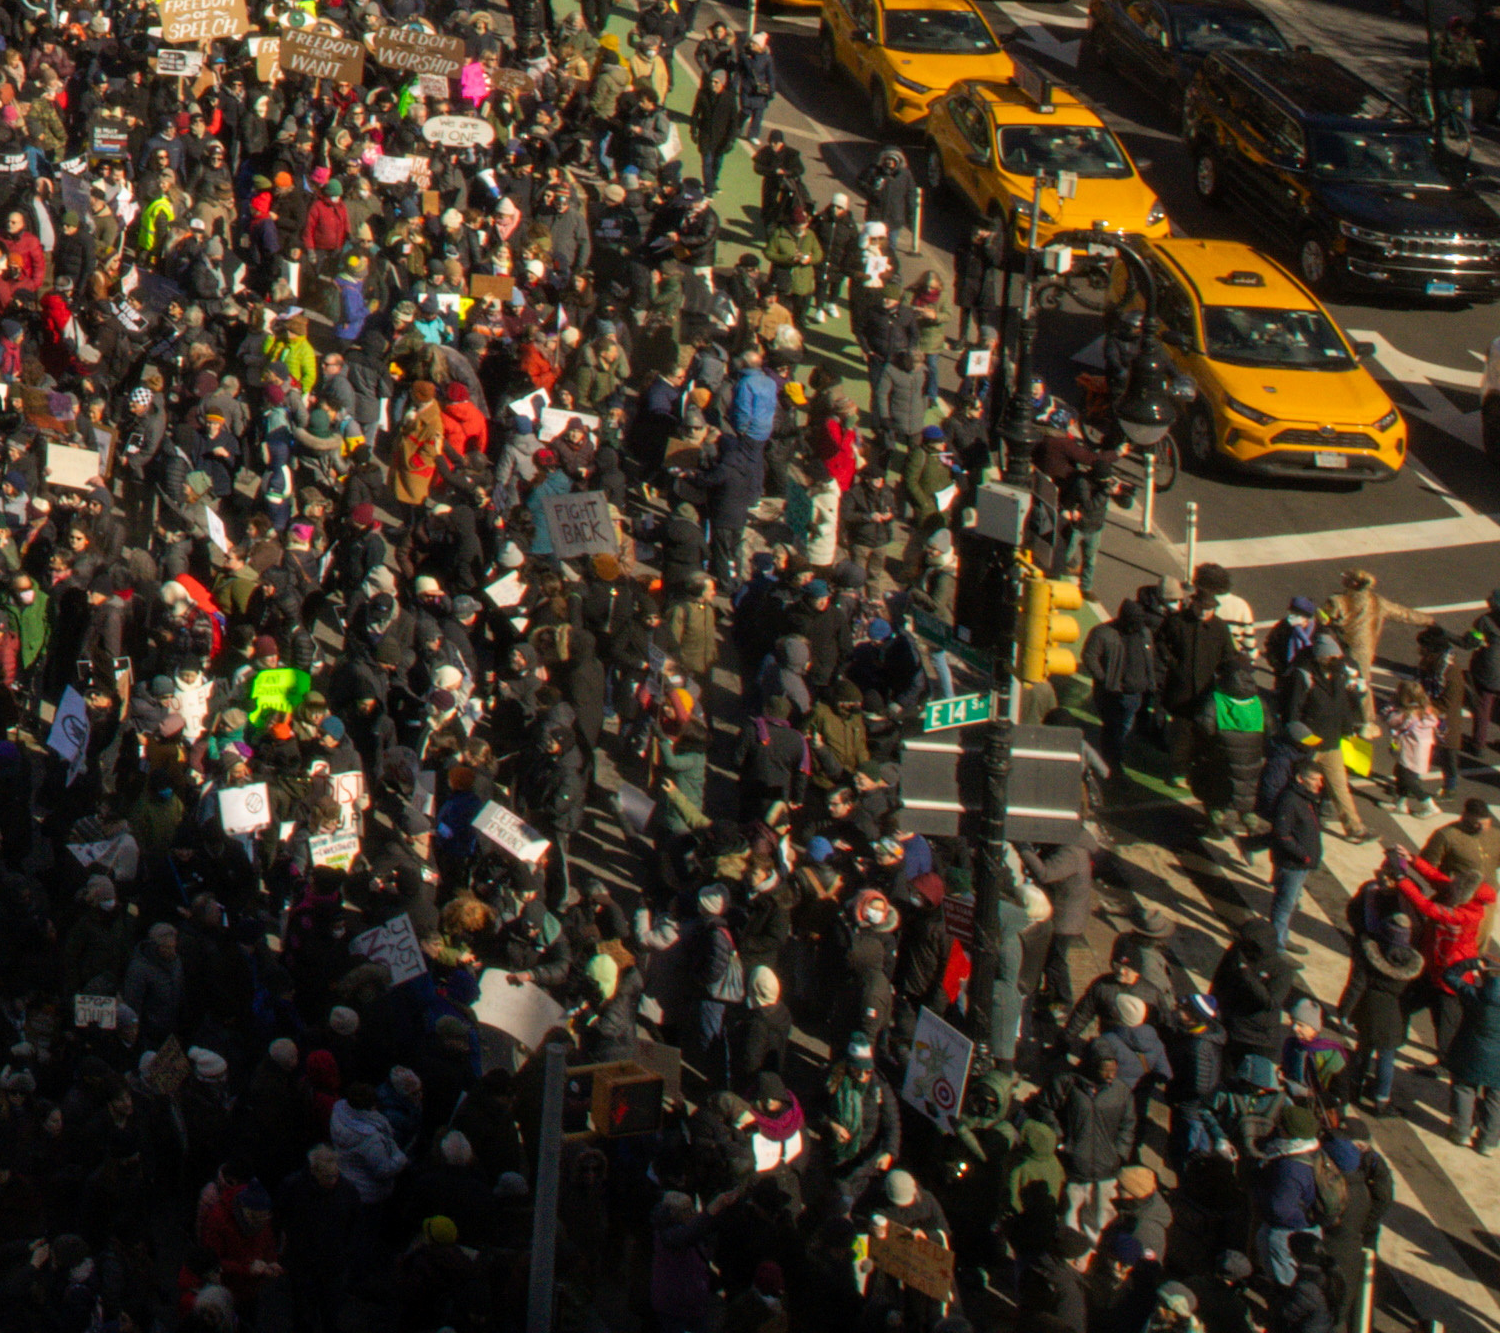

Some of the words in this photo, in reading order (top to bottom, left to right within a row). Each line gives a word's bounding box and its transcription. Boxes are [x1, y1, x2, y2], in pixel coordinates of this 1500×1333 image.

[192, 10, 209, 20] OF
[168, 18, 239, 40] SPEECH
[378, 25, 457, 50] FREEDOM
[286, 30, 360, 58] FREEDOM
[291, 54, 343, 78] WANT
[379, 46, 459, 75] WORSHIP
[448, 130, 480, 143] ONE
[553, 501, 597, 521] FIGHT
[561, 521, 608, 544] BACK
[930, 705, 942, 728] E
[948, 701, 967, 723] 14
[390, 919, 423, 973] JUST
